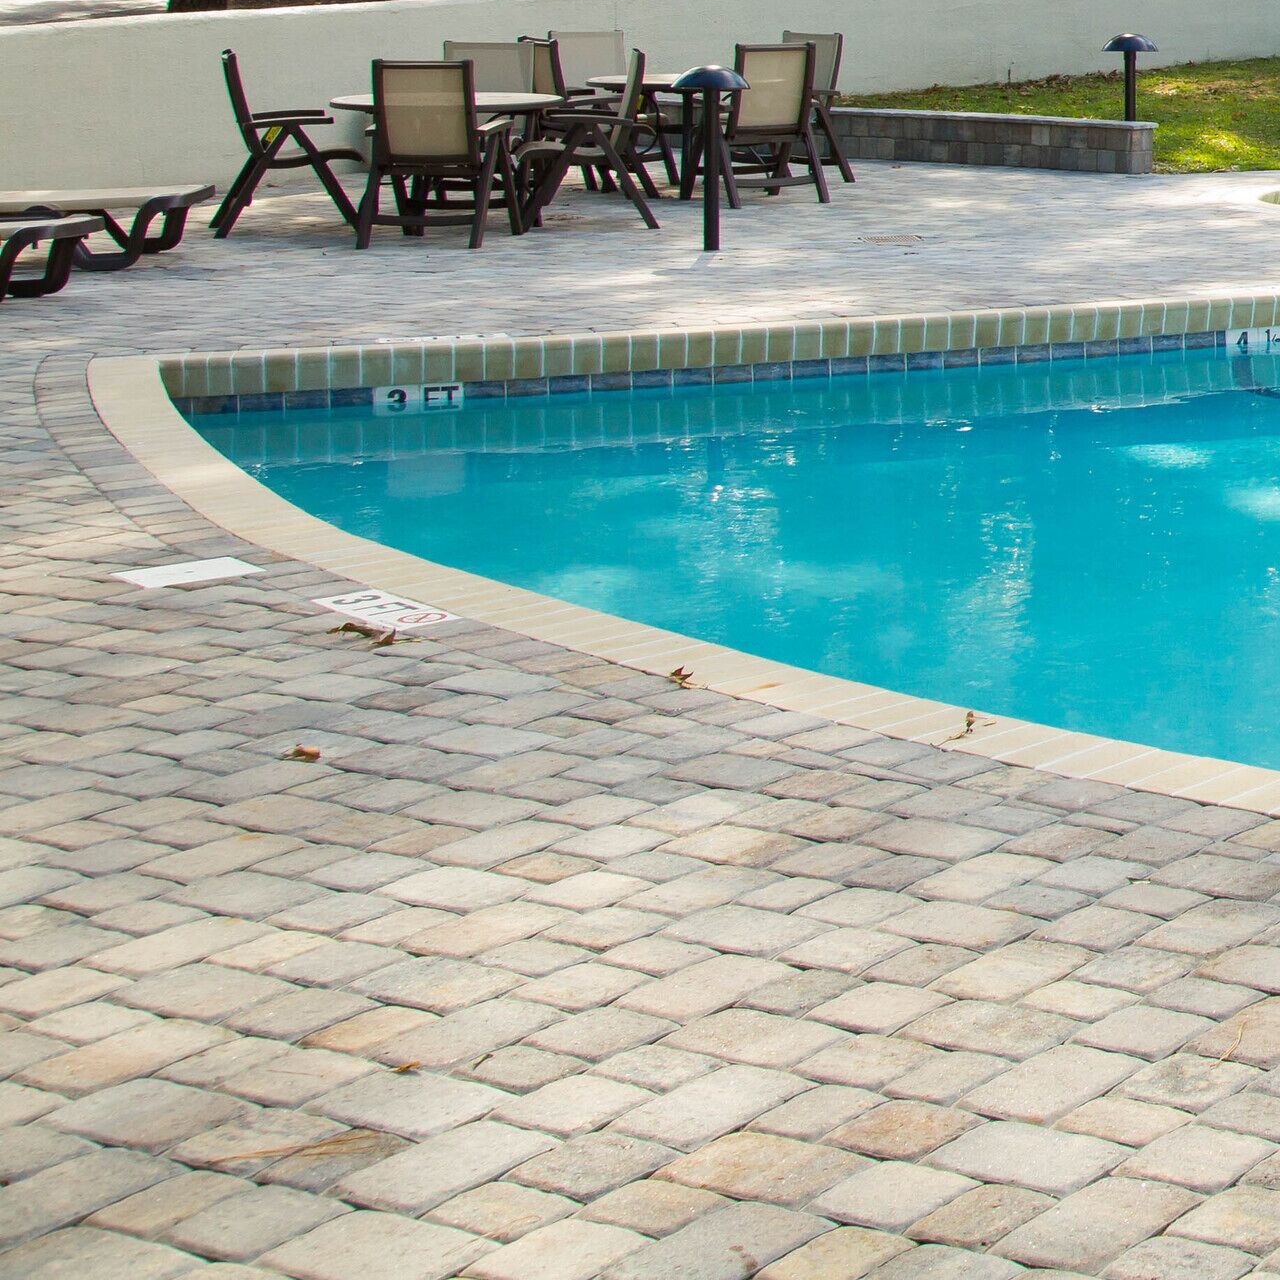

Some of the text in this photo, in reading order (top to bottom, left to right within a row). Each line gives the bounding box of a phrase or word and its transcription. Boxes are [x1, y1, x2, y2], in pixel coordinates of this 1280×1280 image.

[424, 386, 460, 401] FT
[332, 594, 420, 617] 3 FT
